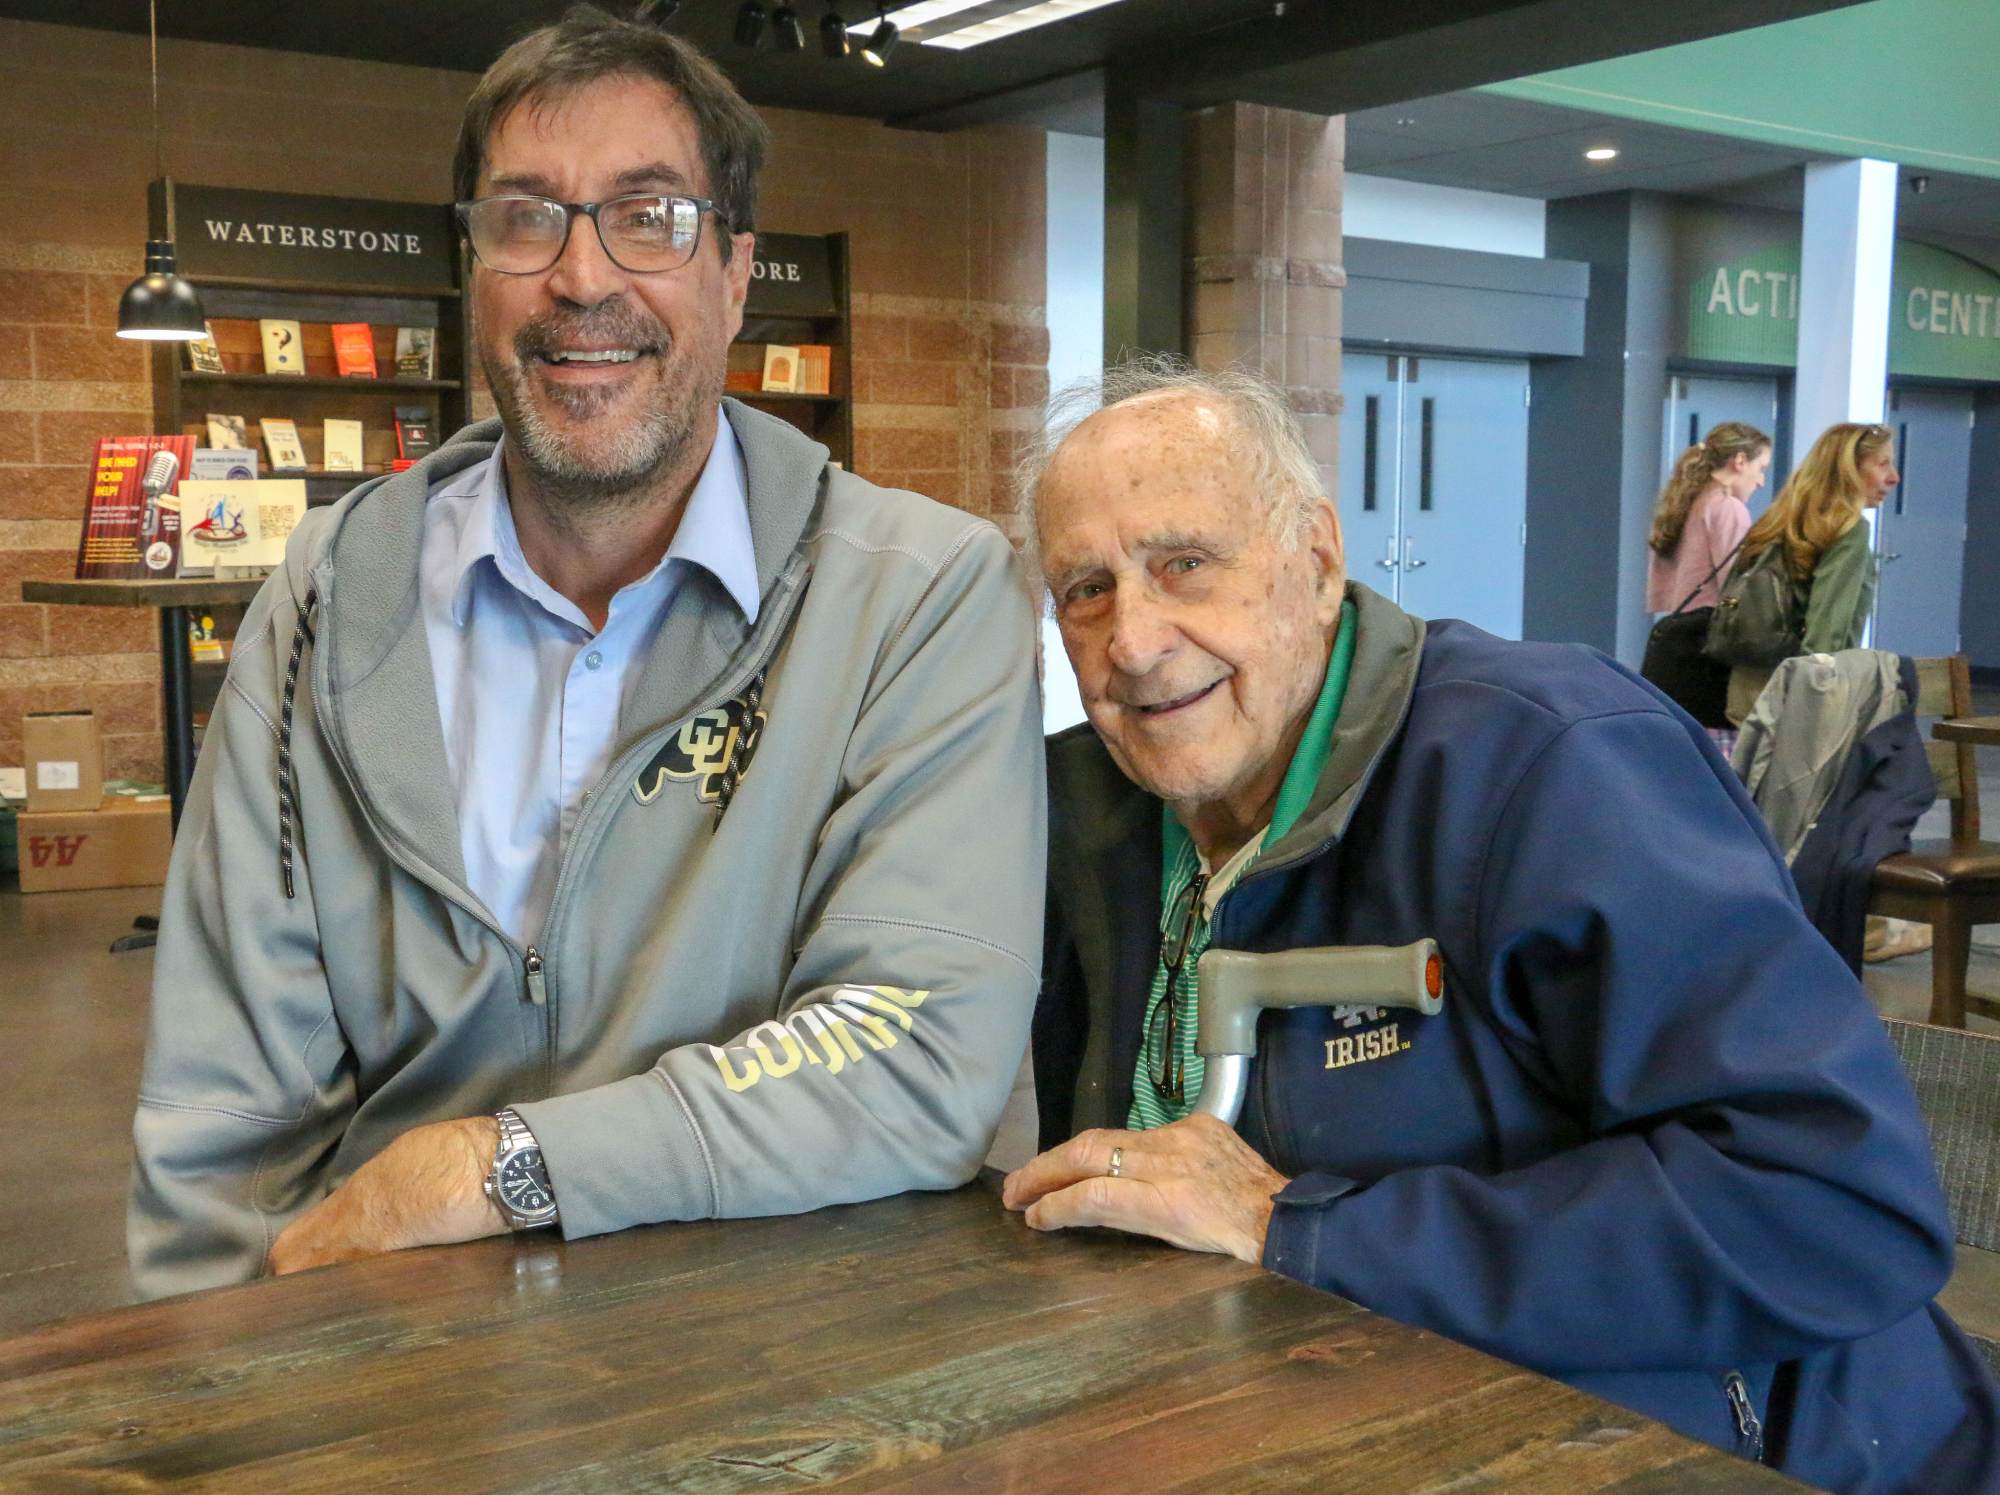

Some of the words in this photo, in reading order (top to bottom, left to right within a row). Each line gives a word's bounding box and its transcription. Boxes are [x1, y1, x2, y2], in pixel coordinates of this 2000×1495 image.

[205, 220, 421, 254] WATERSTONE
[751, 261, 800, 281] ORE
[1707, 267, 1798, 320] ACTI
[1906, 286, 2000, 338] CENT
[1324, 1022, 1400, 1069] IRISH
